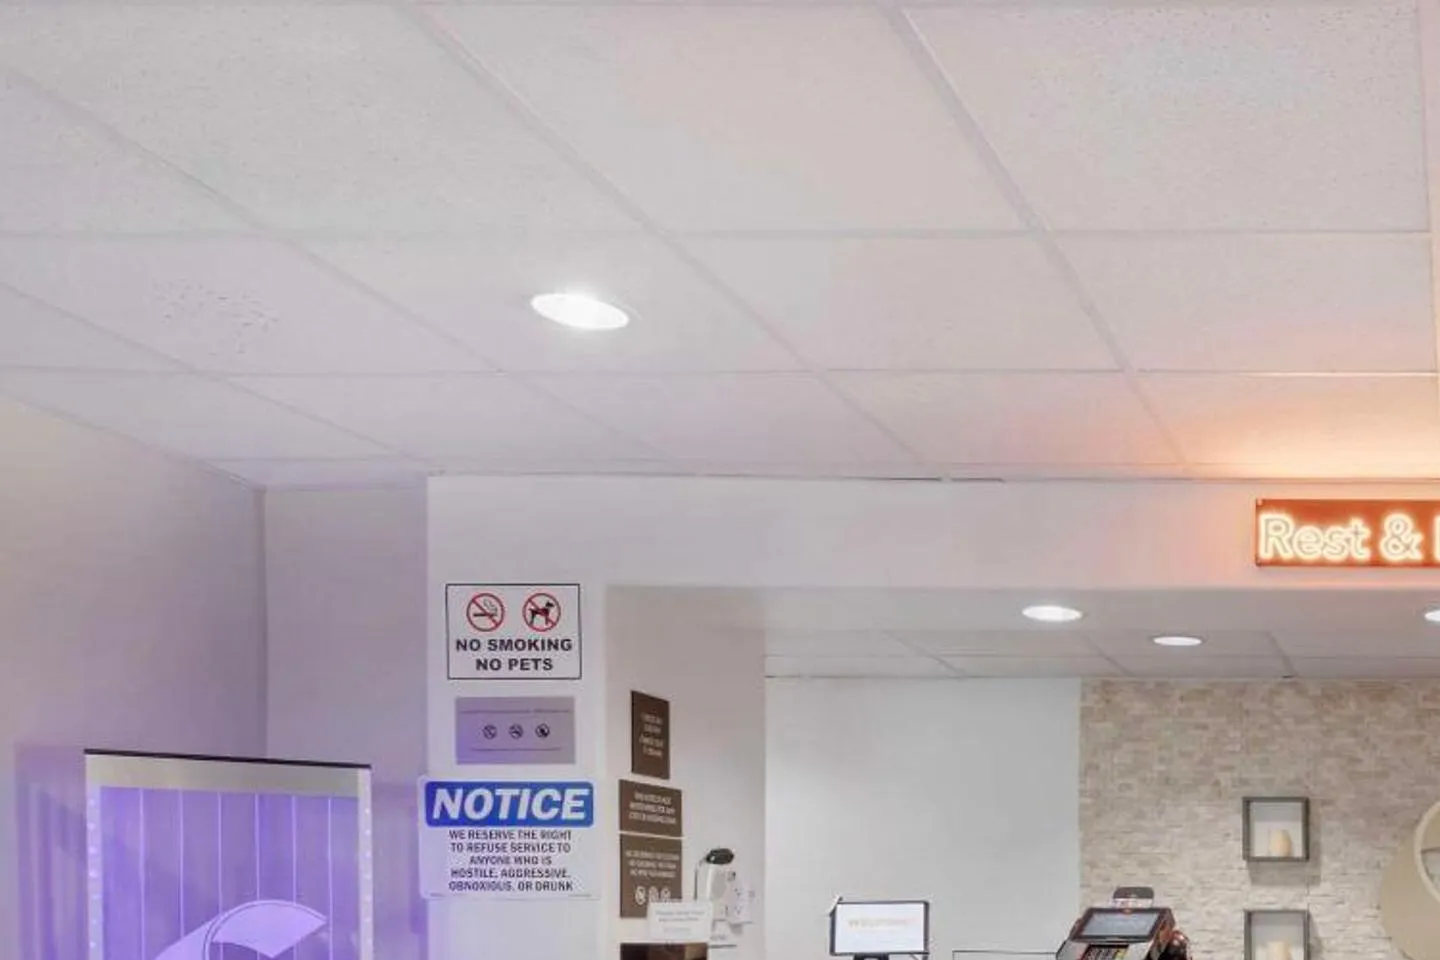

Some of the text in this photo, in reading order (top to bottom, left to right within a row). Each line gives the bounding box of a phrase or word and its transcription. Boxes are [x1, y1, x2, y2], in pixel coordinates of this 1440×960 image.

[1258, 511, 1371, 560] Rest
[1379, 511, 1424, 562] &
[456, 638, 573, 652] NO SMOKING
[475, 658, 554, 671] NO PETS
[432, 787, 590, 821] NOTICE
[449, 829, 572, 841] WE RESERVE THE RIGHT
[450, 842, 571, 853] TO REFUSE SERVICE TO
[469, 855, 552, 865] ANYONE WHO IS
[517, 880, 533, 891] OR
[535, 881, 573, 891] DRUNK
